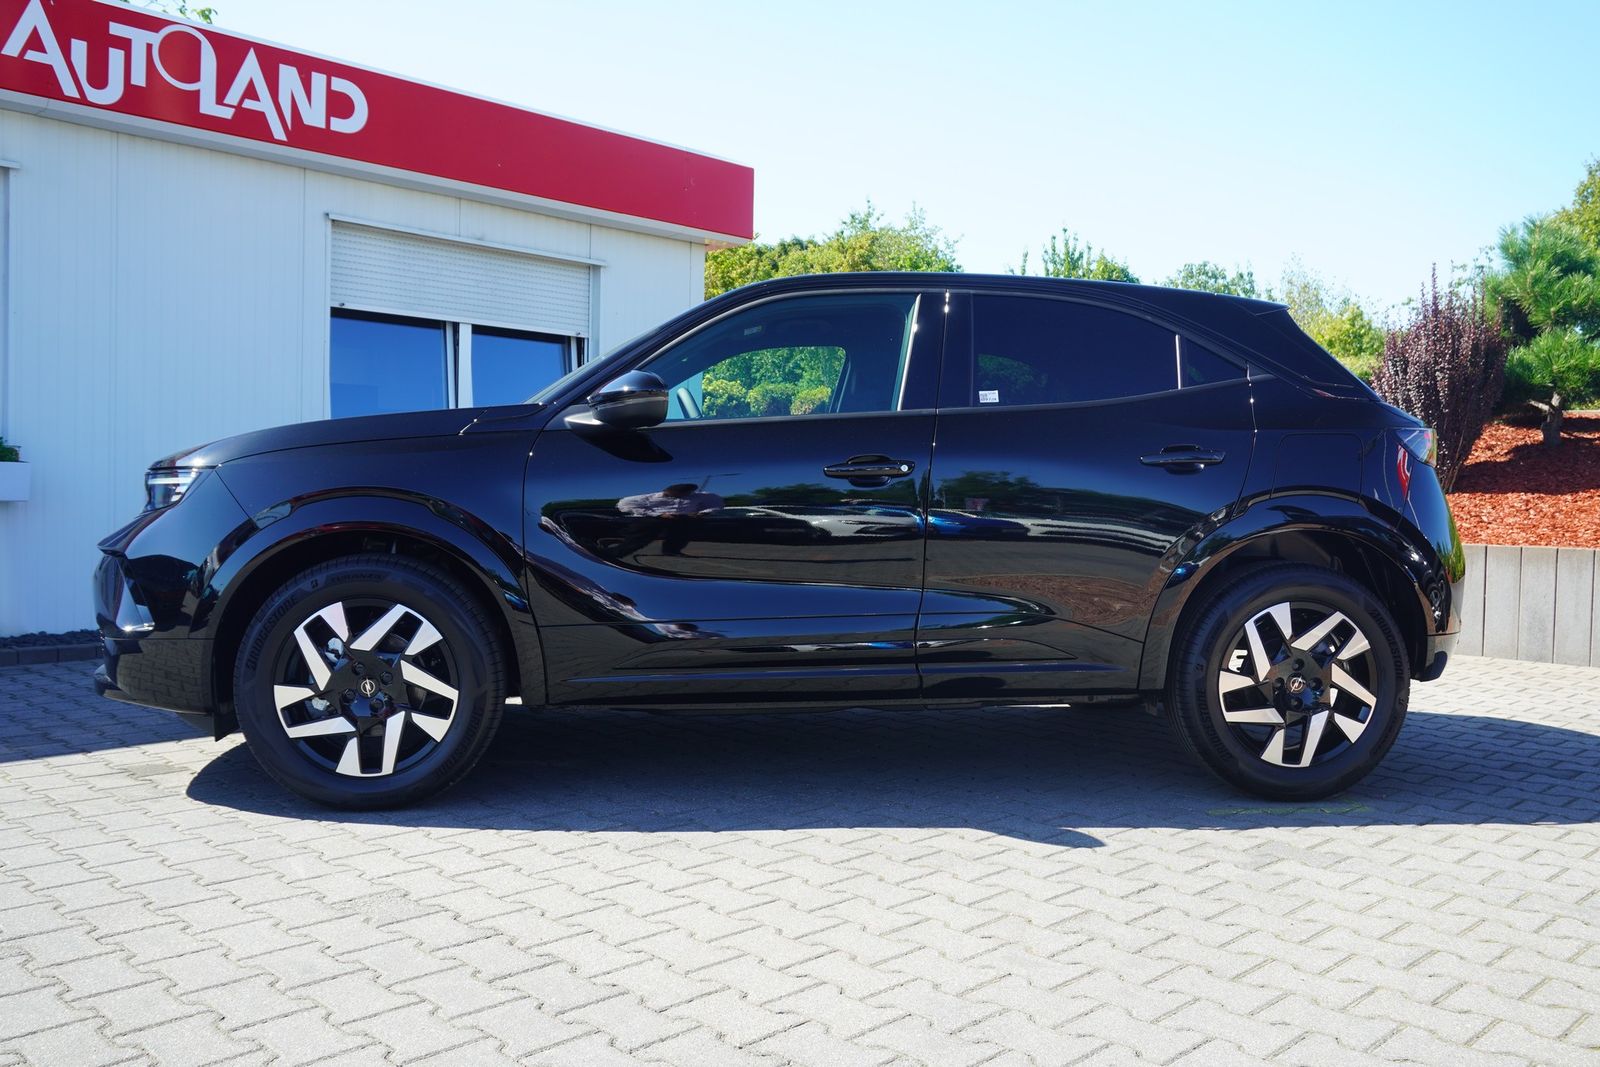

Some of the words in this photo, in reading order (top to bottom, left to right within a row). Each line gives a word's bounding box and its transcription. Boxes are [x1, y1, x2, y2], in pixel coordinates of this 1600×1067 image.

[1, 0, 369, 142] AUTOLAND
[246, 596, 299, 671] BRIDGESTONE
[1368, 608, 1405, 681] BRIDGESTONE
